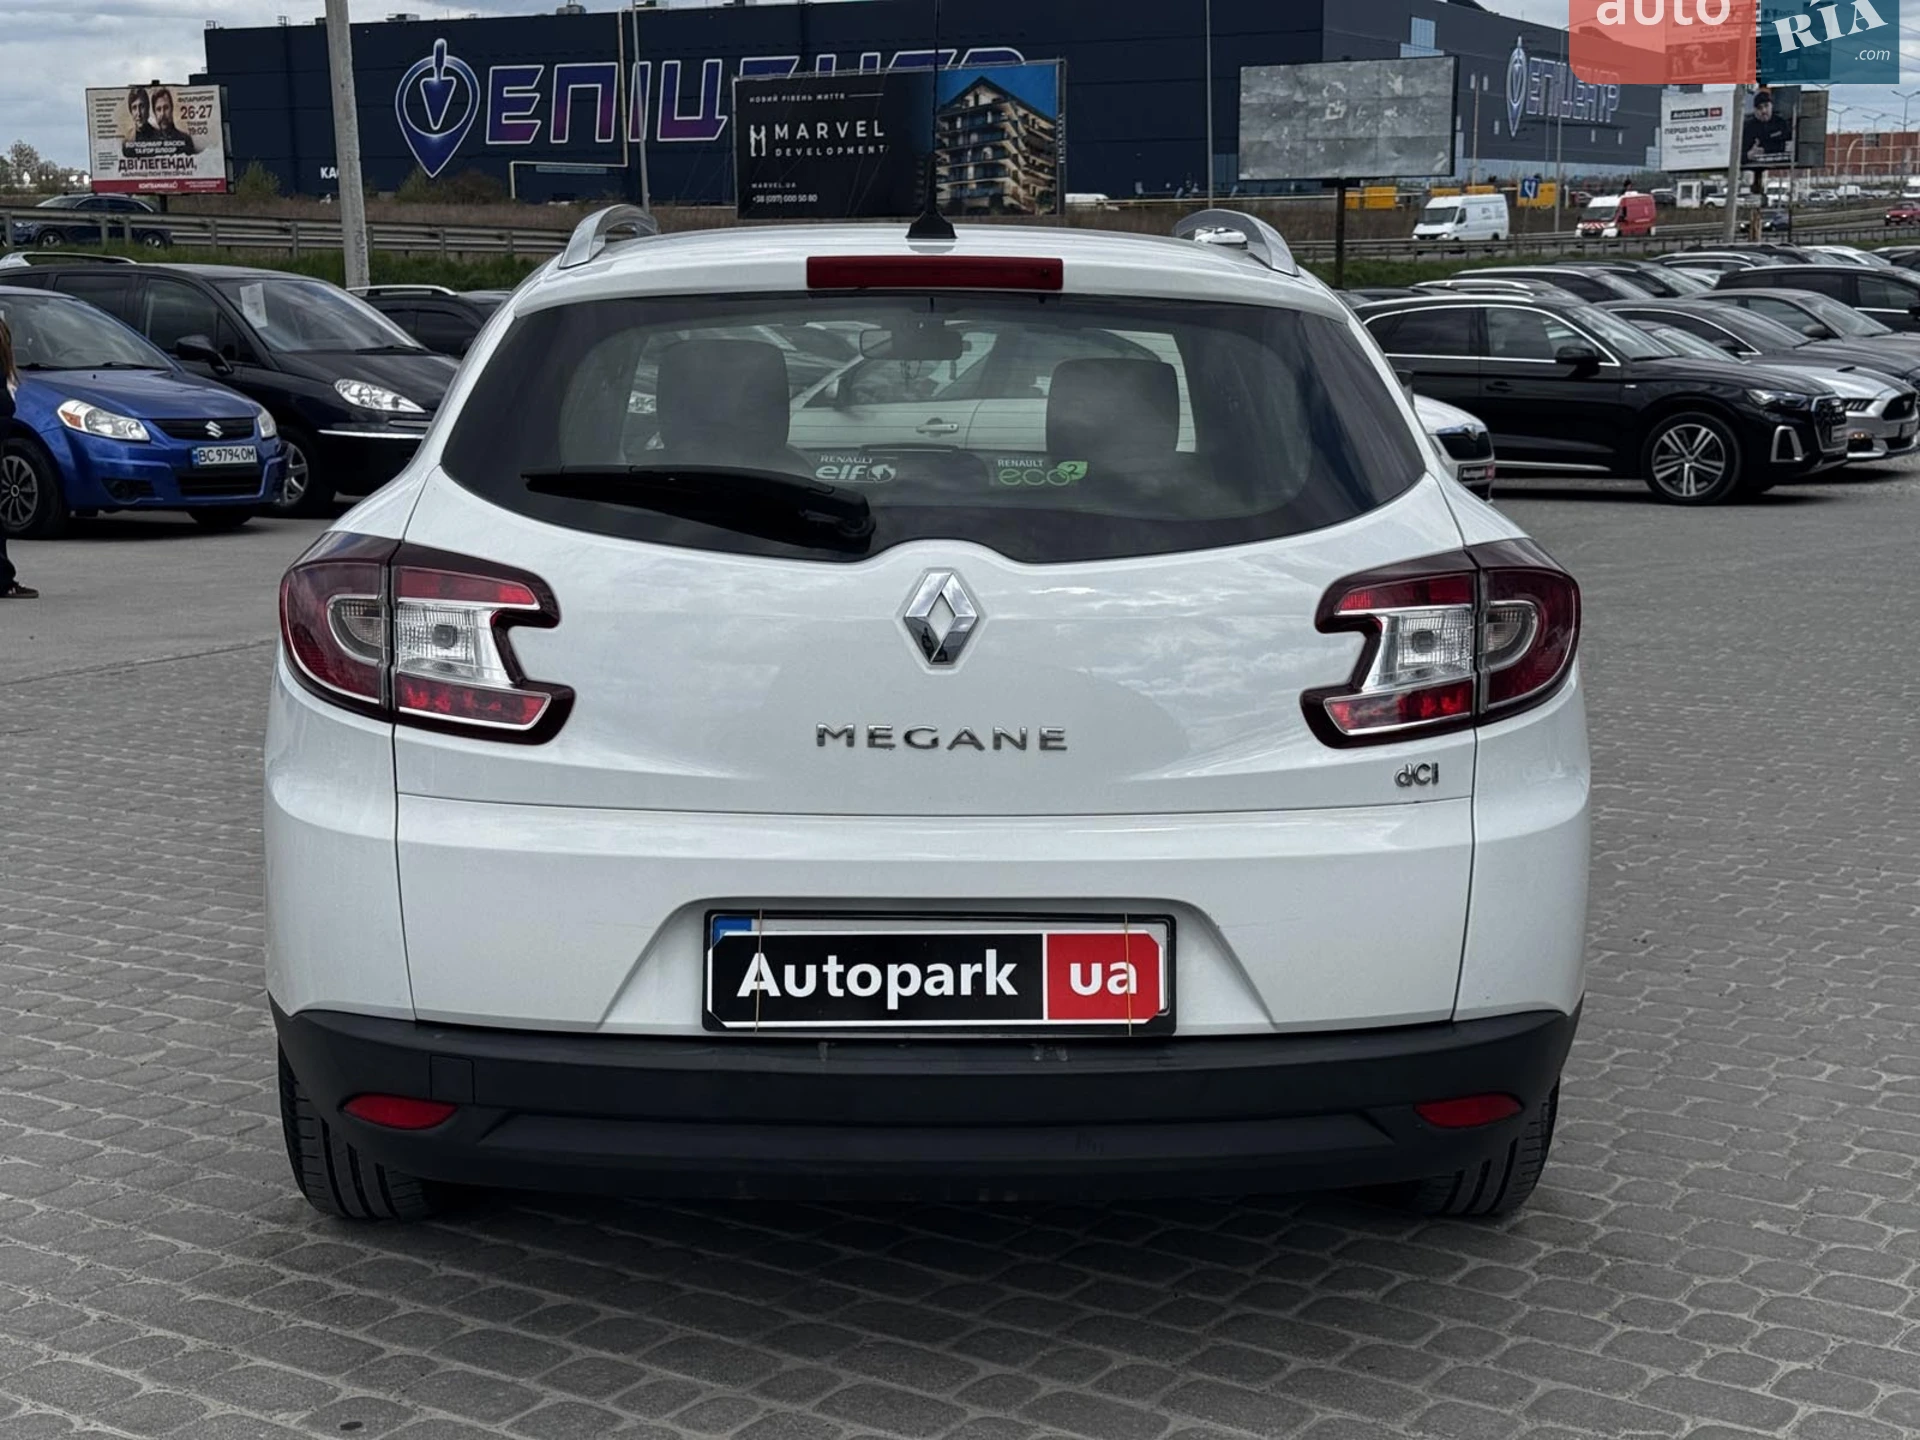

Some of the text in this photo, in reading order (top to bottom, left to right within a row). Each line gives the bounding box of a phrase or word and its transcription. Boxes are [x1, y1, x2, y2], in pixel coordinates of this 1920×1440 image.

[774, 120, 885, 140] MARVEL
[775, 144, 885, 157] DEVELOPMENT
[119, 158, 139, 173] ДВІ
[998, 459, 1043, 467] RENAULT
[815, 465, 867, 480] elf
[814, 723, 1068, 752] MEGANE
[736, 948, 1137, 1010] Autopark ua
